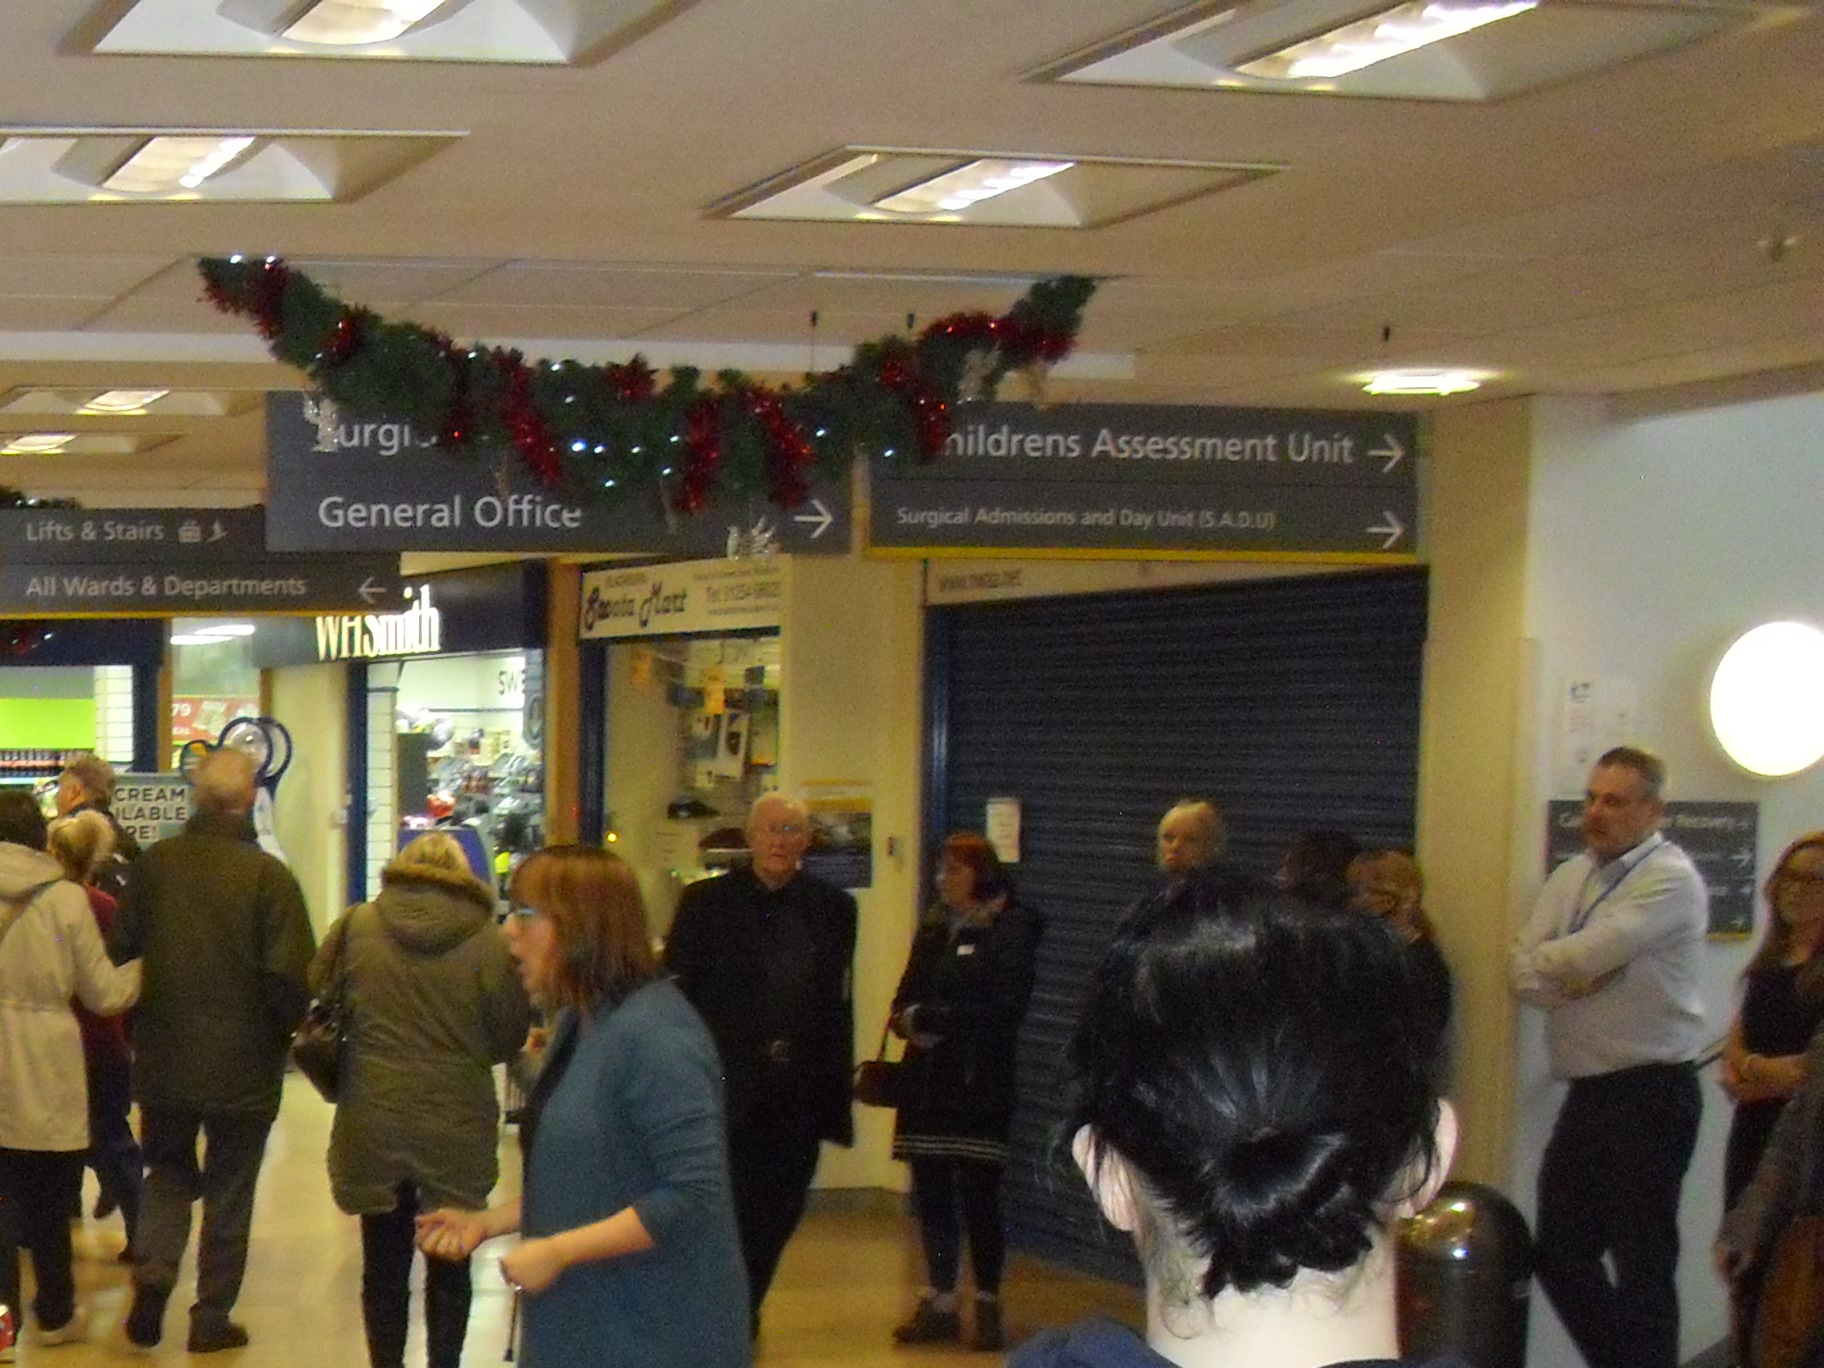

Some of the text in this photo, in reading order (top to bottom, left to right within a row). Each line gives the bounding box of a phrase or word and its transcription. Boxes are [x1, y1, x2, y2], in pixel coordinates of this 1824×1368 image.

[336, 416, 438, 456] urgi
[943, 423, 1354, 464] hildrens Assessment Unit
[318, 493, 581, 529] General Office
[896, 506, 969, 529] Surgical
[975, 506, 1076, 527] Admissions
[1080, 507, 1114, 527] and
[1119, 508, 1152, 530] Day
[1158, 510, 1194, 528] Unit
[25, 519, 165, 542] Lifts & Stairs
[25, 575, 307, 600] All Wards & Departments
[315, 583, 440, 662] WHSmith
[114, 787, 186, 802] CREAM
[115, 805, 187, 821] ILABLE
